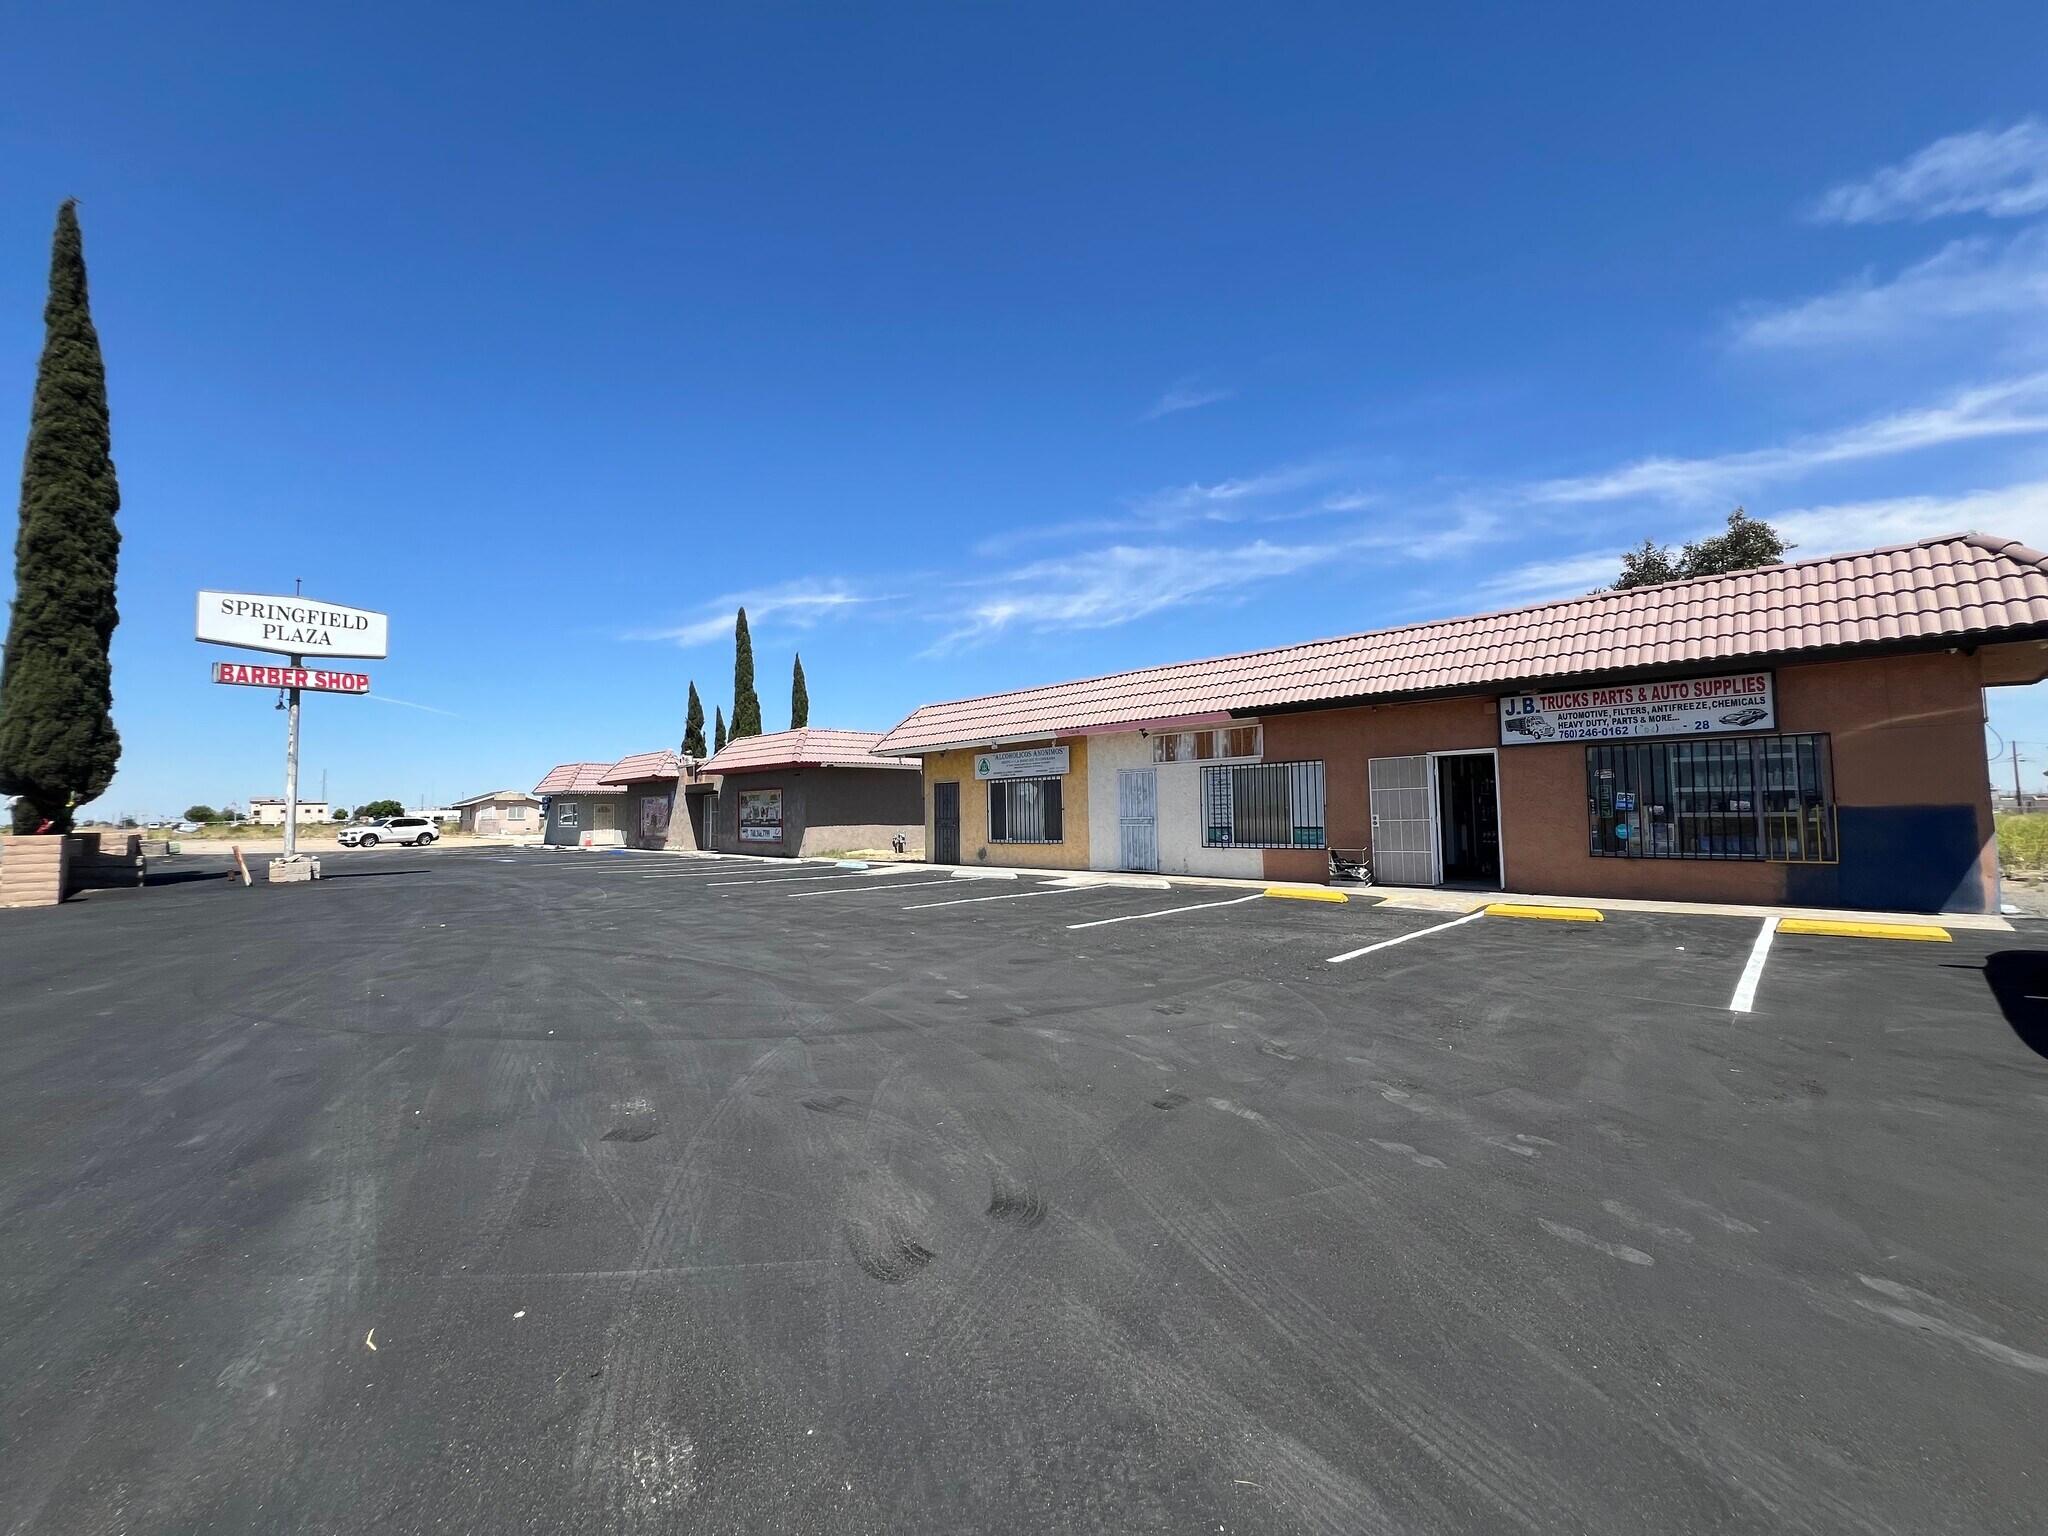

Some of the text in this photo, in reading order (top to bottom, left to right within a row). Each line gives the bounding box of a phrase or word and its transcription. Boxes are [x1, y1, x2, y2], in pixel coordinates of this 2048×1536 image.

[221, 599, 369, 631] SPRINGFIELD
[262, 623, 332, 646] PLAZA
[219, 663, 369, 691] BARBER SHOP
[1505, 675, 1766, 716] J.B. TRUCKS PARTS & AUTO SUPPLIES
[1558, 696, 1766, 720] AUTOMOTIVE, FILTERS, ANTIFREEZE, CHEMICALS
[1557, 720, 1584, 730] HEAVY
[1586, 718, 1609, 728] DUTY,
[1612, 717, 1638, 725] PARTS
